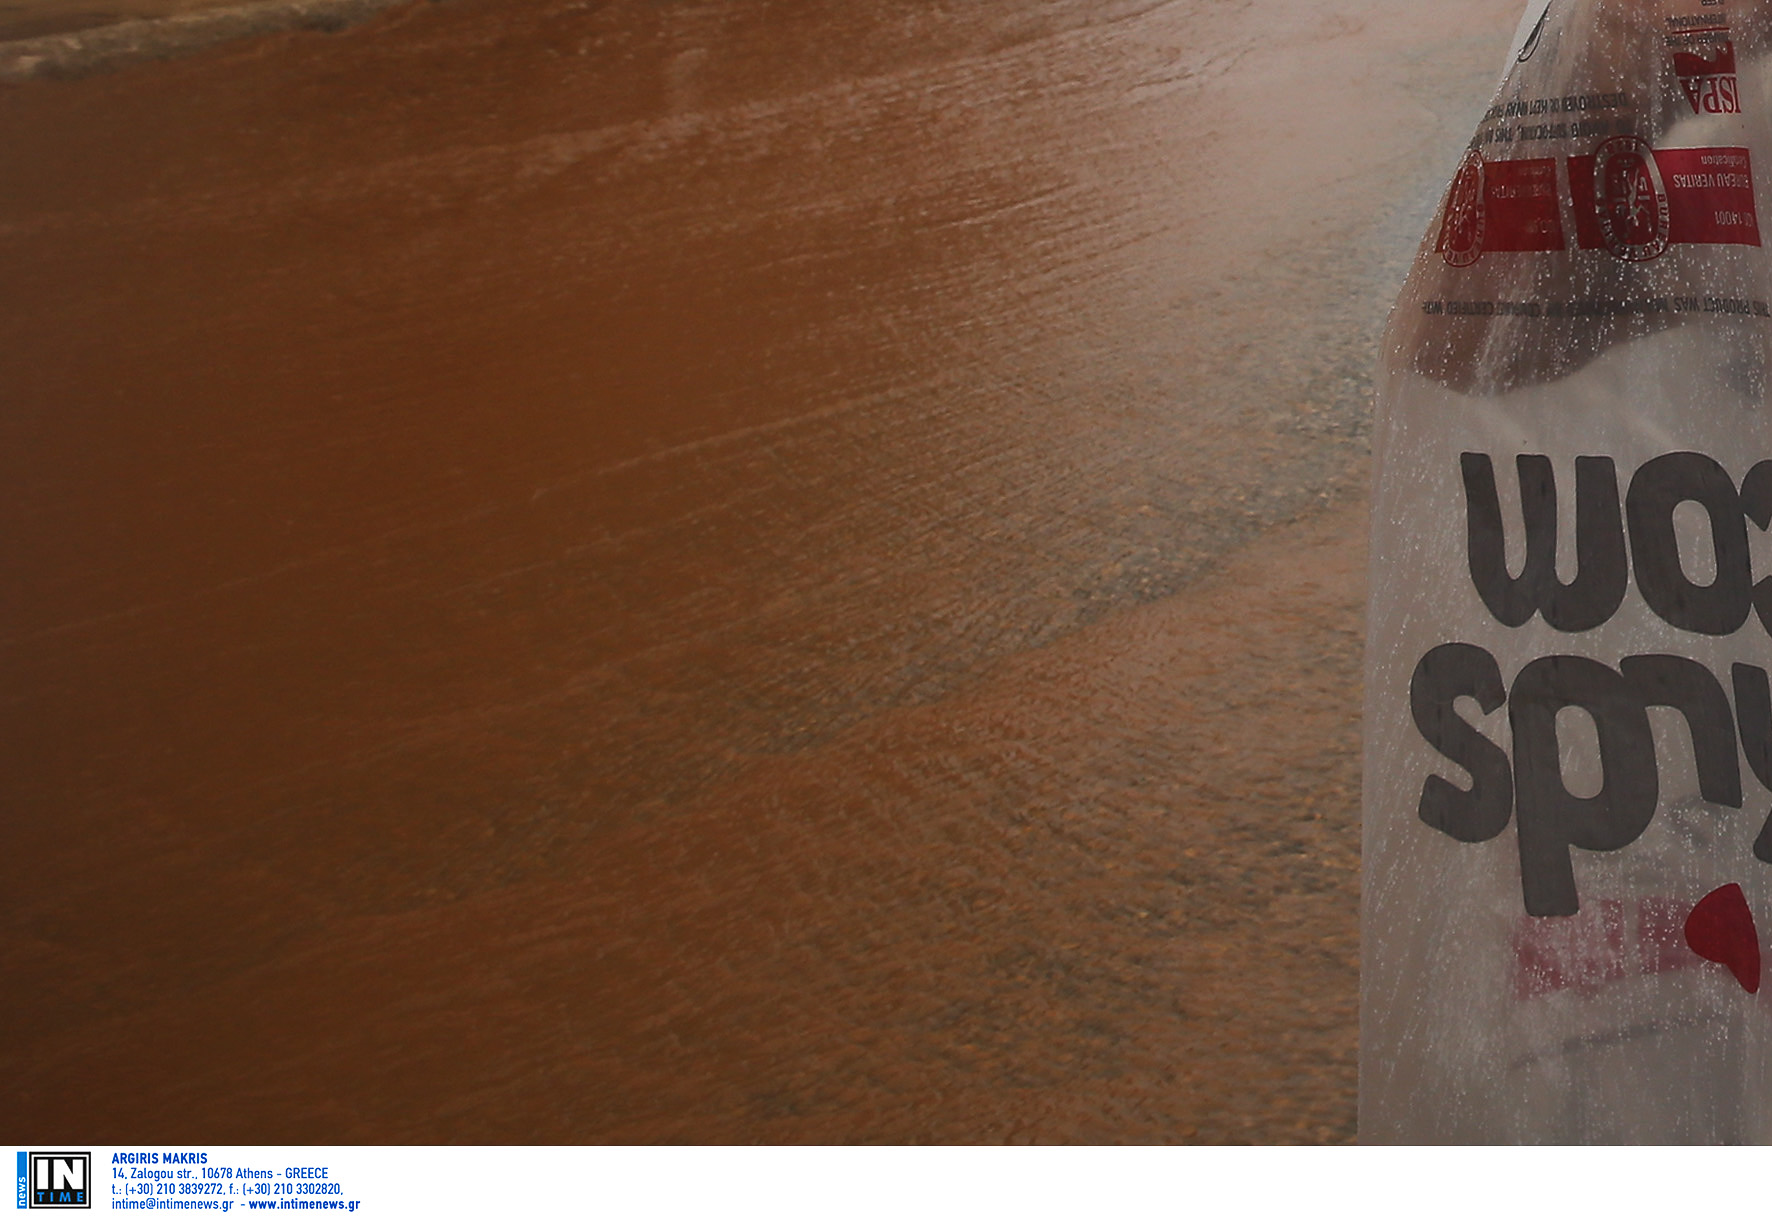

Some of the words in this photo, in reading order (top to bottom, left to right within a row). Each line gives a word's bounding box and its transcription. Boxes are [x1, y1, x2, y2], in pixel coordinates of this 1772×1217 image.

[1679, 76, 1742, 115] ISPA
[1671, 173, 1715, 190] VERITAS
[1714, 210, 1744, 226] 14001
[1672, 297, 1700, 312] WAS
[1703, 297, 1751, 316] PRODUCT
